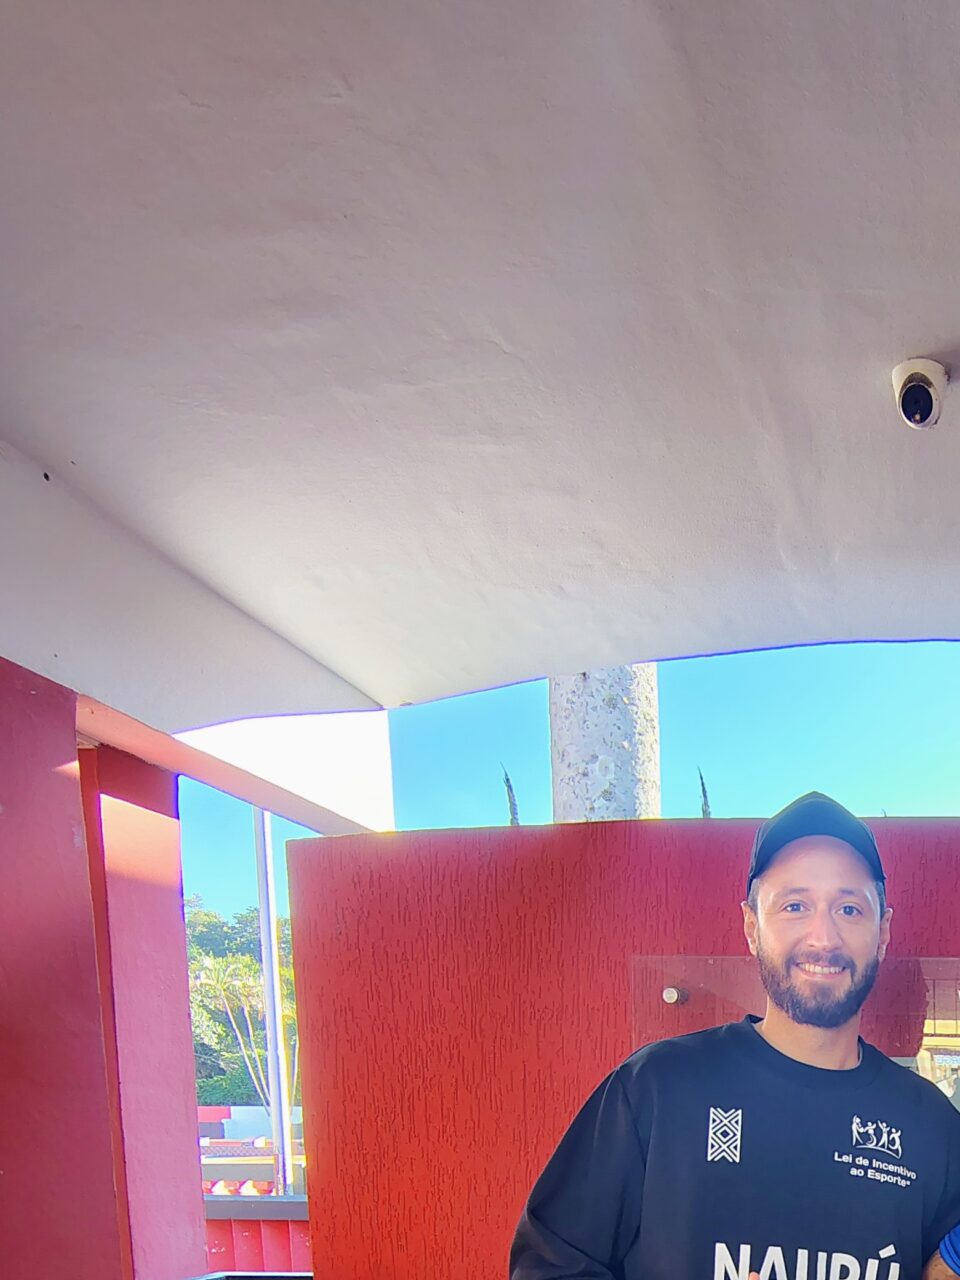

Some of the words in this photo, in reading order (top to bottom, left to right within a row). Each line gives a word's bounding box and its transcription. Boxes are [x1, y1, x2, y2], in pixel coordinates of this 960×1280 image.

[834, 1151, 853, 1163] Lei
[855, 1156, 869, 1167] de
[872, 1158, 917, 1180] Incentivo
[850, 1167, 864, 1177] ao
